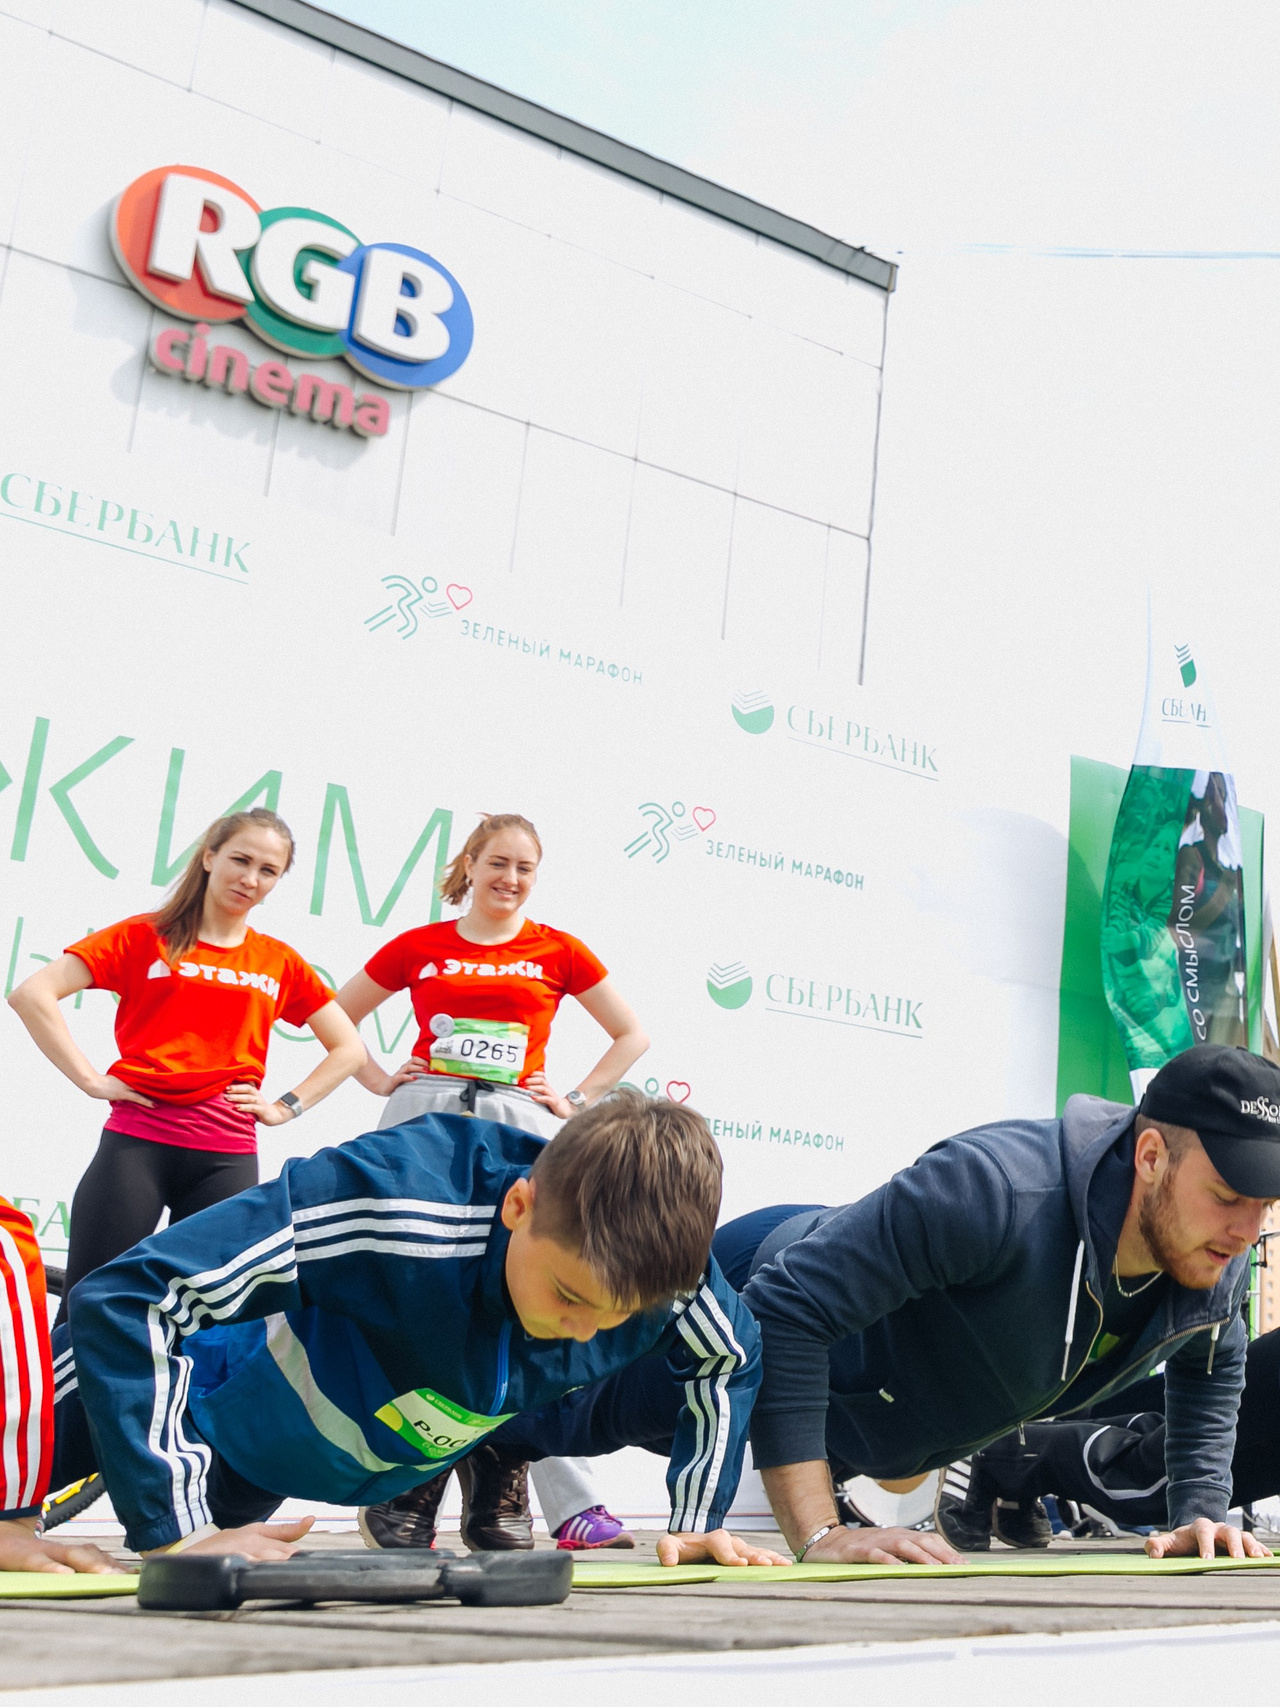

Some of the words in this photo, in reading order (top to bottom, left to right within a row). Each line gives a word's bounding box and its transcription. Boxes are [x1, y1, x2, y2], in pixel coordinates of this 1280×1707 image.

[148, 172, 454, 362] RGB
[152, 323, 391, 436] cinema
[0, 473, 251, 573] СБЕРБАНК
[460, 619, 550, 659] ЗЕЛЕНЫЙ
[559, 648, 643, 685] МАРАФОН
[787, 704, 938, 772] СБЕРБАНК
[706, 839, 785, 872] ЗЕЛЕНЫЙ
[792, 859, 865, 890] МАРАФОН
[1175, 884, 1199, 1003] СМЫСЛОМ
[765, 973, 923, 1029] СБЕРБАНК
[460, 1038, 519, 1063] 0265
[704, 1117, 763, 1141] ЛЕНЫЙ
[769, 1126, 845, 1151] МАРАФОН
